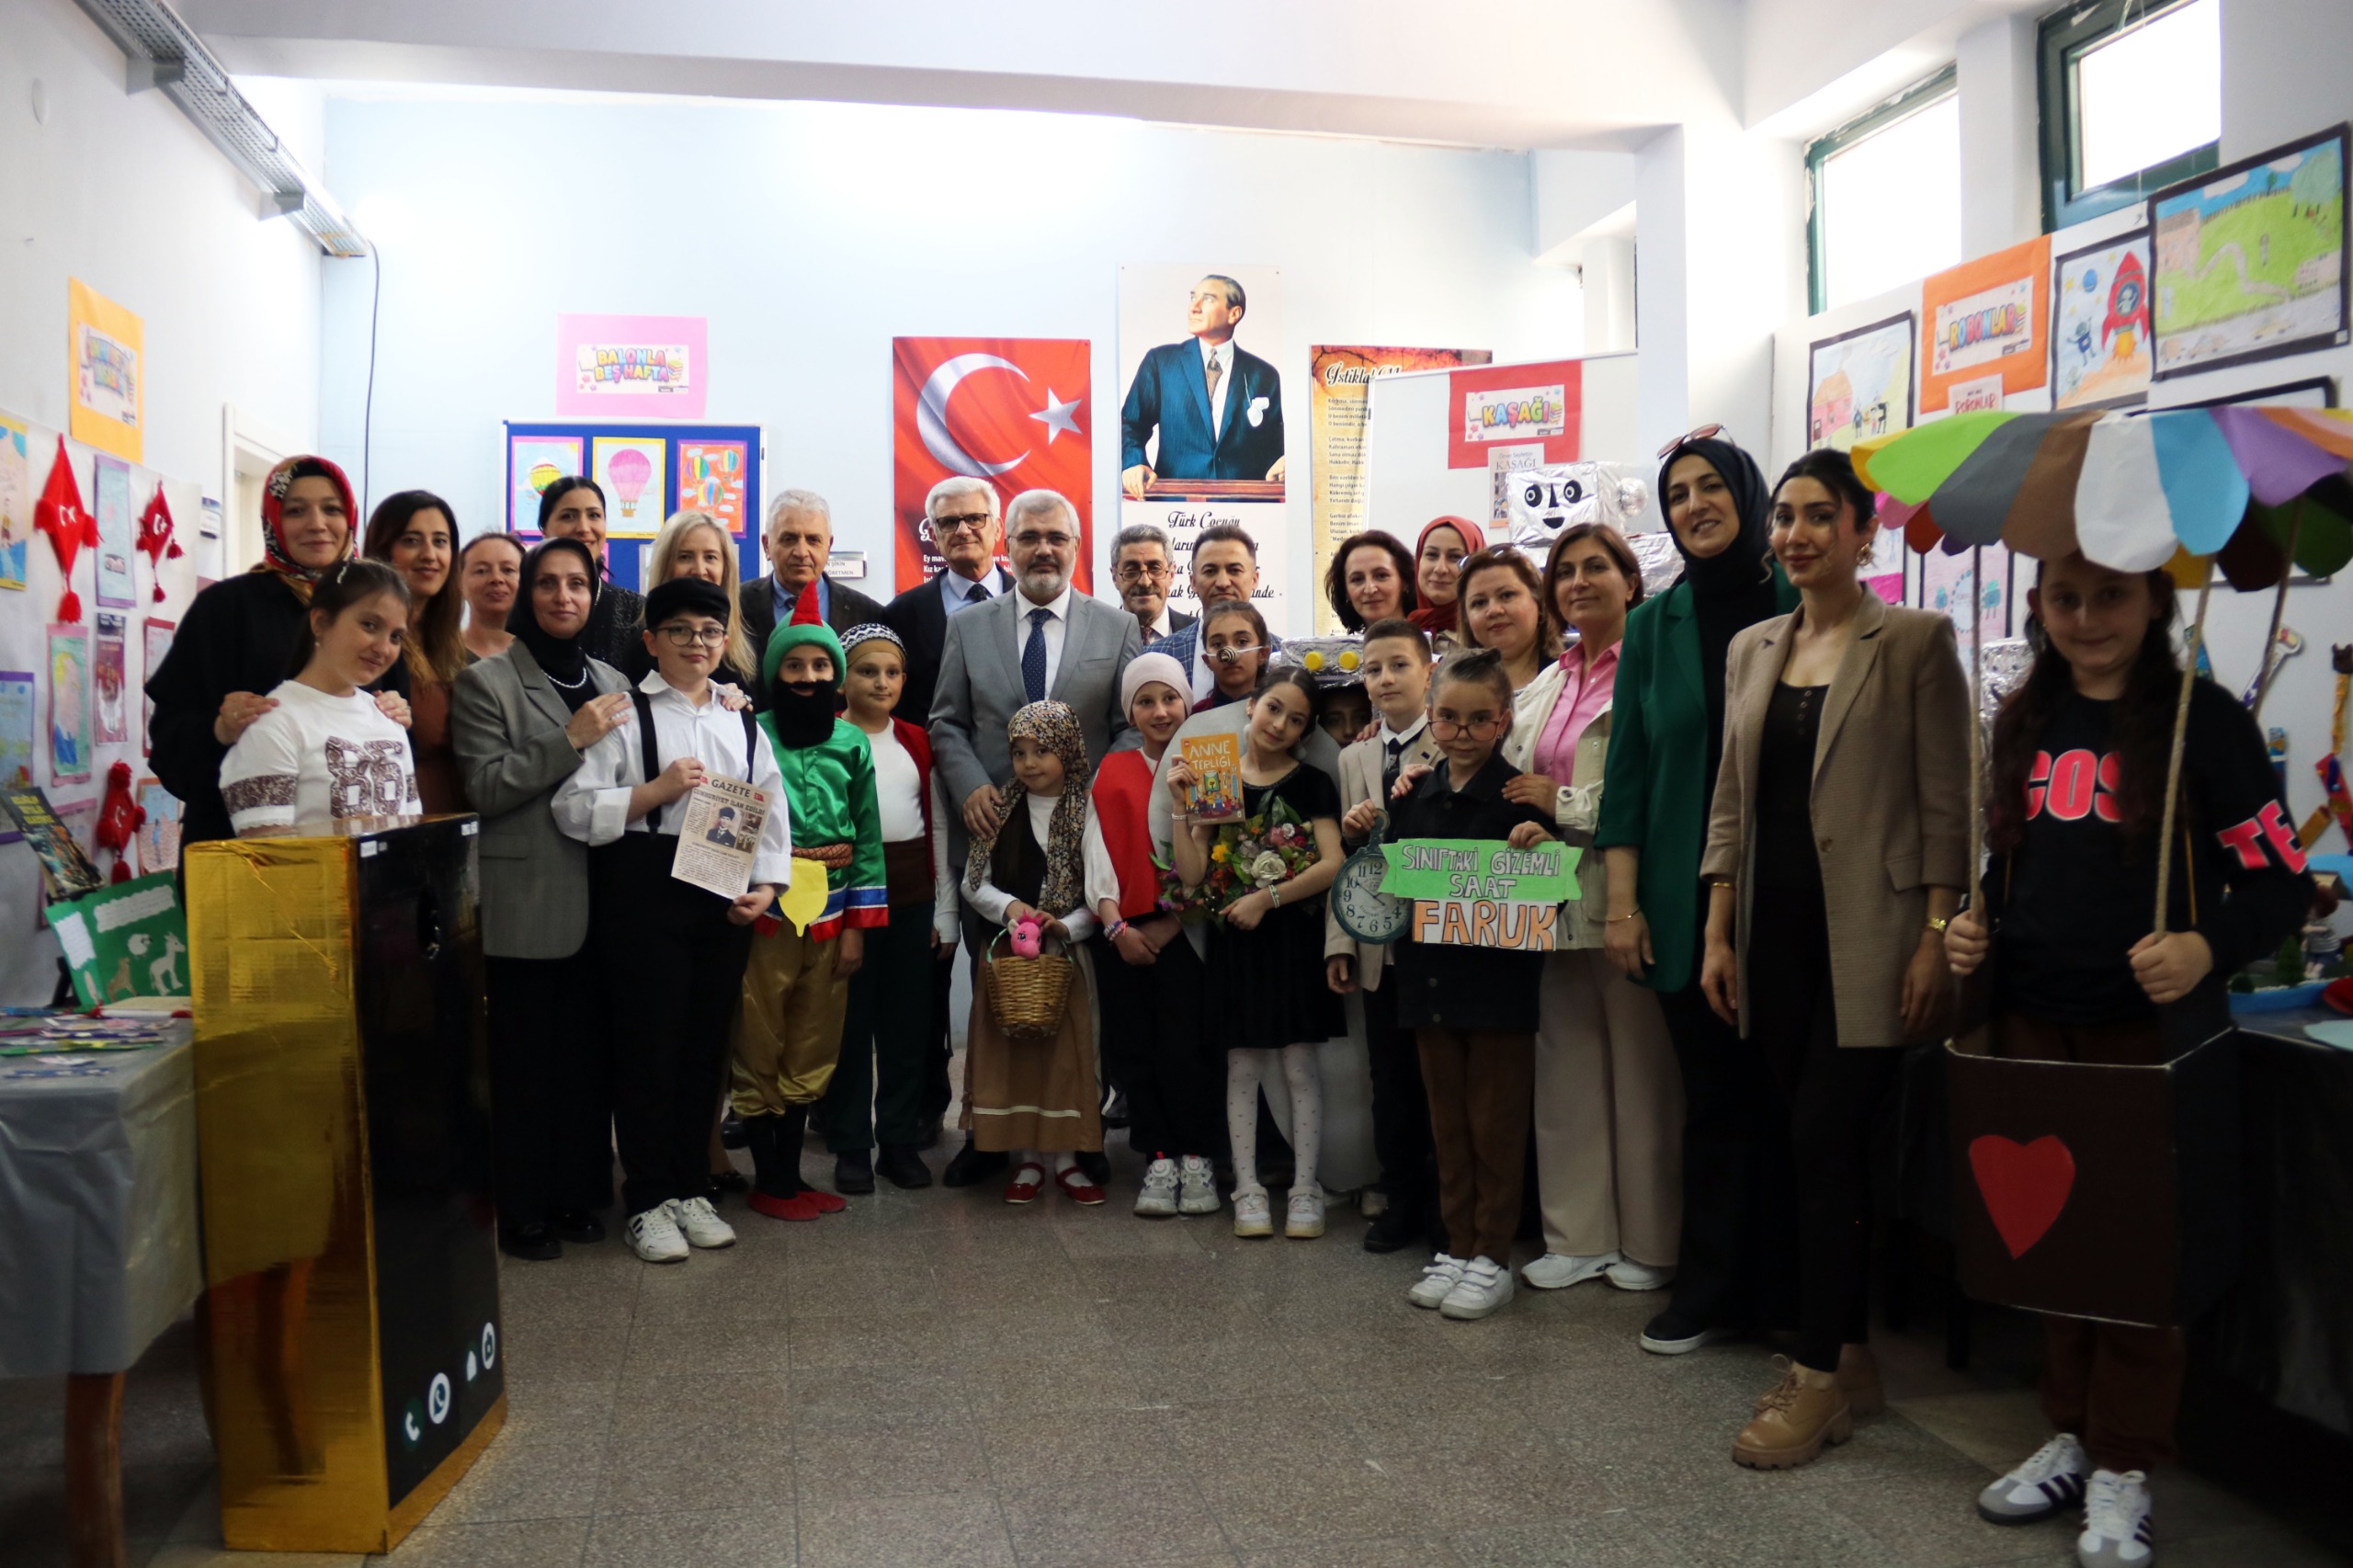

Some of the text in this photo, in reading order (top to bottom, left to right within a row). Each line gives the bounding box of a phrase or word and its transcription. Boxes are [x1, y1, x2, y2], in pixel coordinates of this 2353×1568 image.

[1949, 303, 2016, 352] ROBONLAR
[597, 347, 666, 367] BALONLA
[594, 364, 669, 383] BEŞ HAFTA
[1482, 395, 1551, 428] KAŞAĞI
[1168, 511, 1196, 528] Türk
[924, 554, 930, 563] Ey
[1189, 740, 1231, 759] ANNE
[325, 735, 404, 819] 86
[711, 778, 751, 798] GAZETE
[1369, 862, 1383, 875] 12
[1402, 845, 1562, 876] SINIFTAKİ GİZEMLİ
[1358, 864, 1367, 878] 11
[1346, 875, 1358, 889] 10
[1449, 874, 1518, 899] SAAT
[1344, 889, 1352, 903] 9
[1346, 904, 1355, 918] 8
[1392, 905, 1403, 919] 4
[1357, 915, 1366, 928] 7
[1370, 919, 1379, 933] 6
[1383, 916, 1392, 930] 5
[1412, 900, 1557, 951] FARUK
